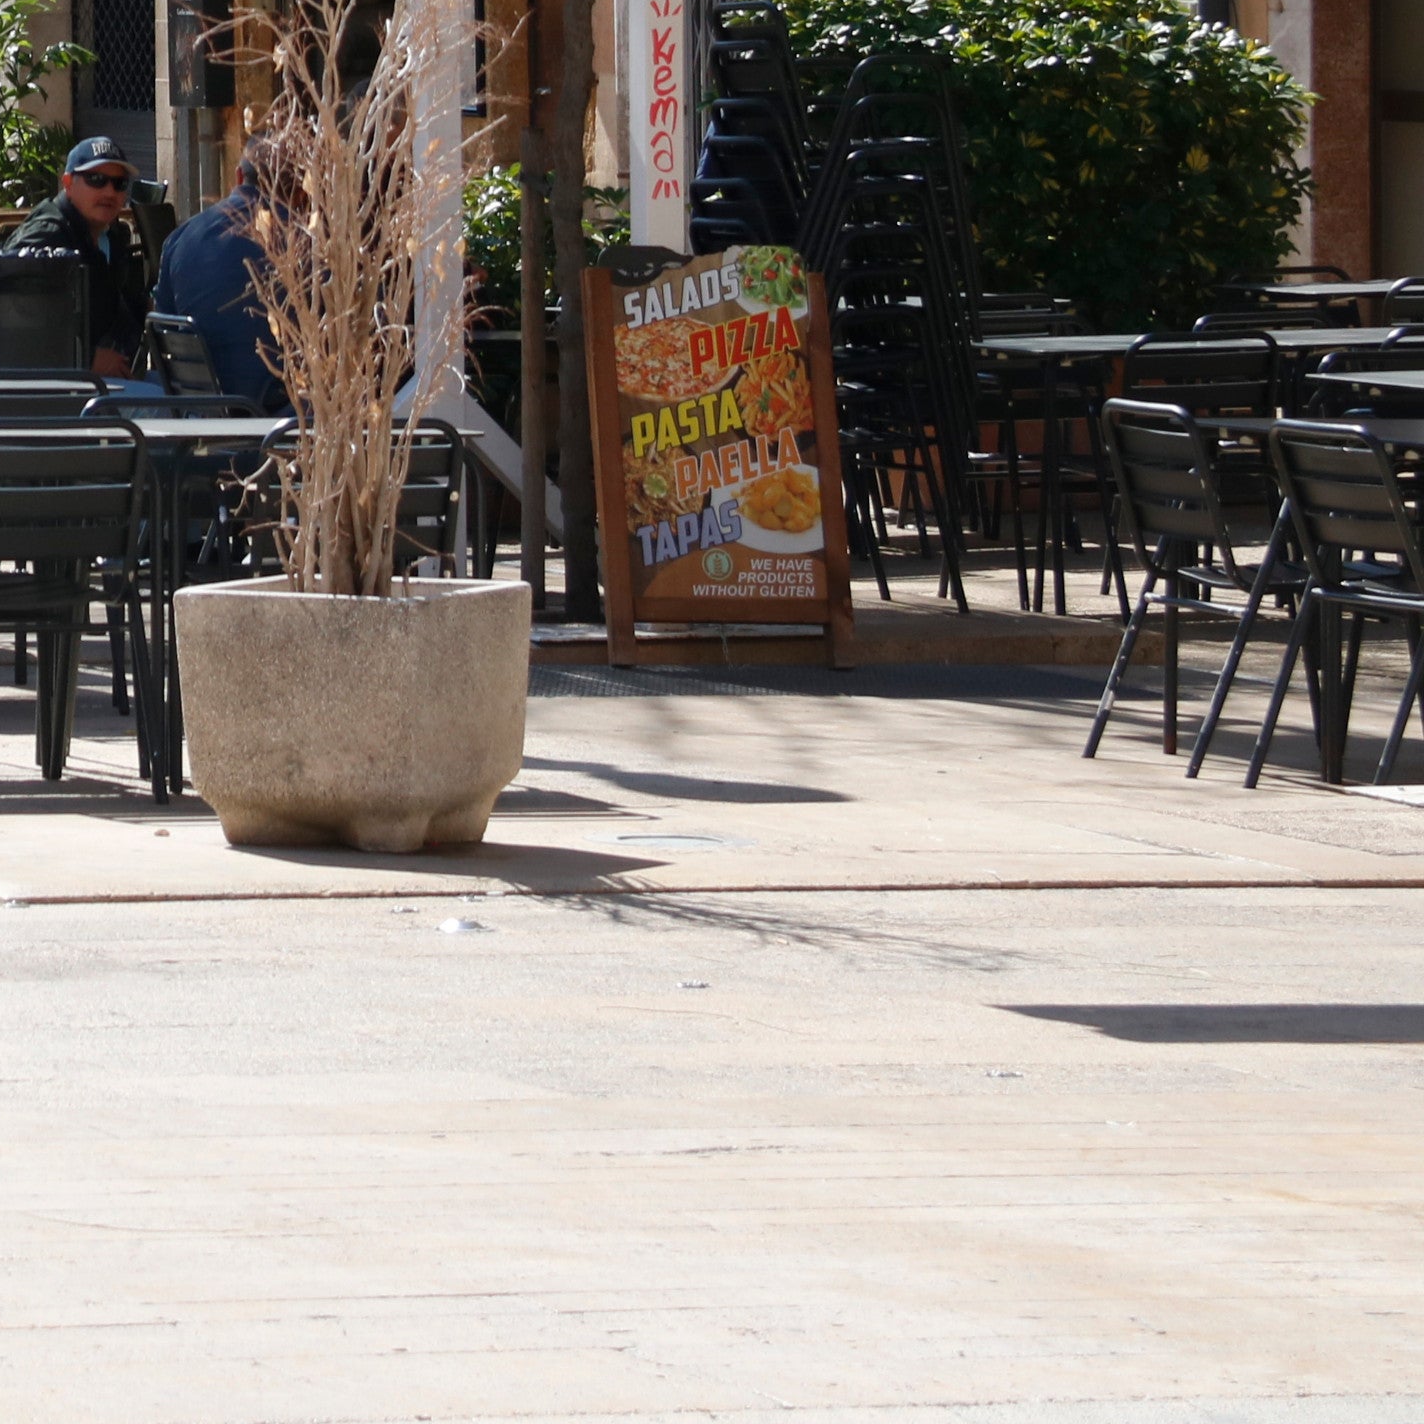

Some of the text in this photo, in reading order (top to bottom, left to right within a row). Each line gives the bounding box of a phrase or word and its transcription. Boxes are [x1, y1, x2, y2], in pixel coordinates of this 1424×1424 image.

[624, 263, 740, 329] SALADS
[688, 306, 801, 378] PIZZA
[631, 388, 743, 459] PASTA
[673, 426, 803, 501] PAELLA
[636, 499, 743, 567] TAPAS
[751, 559, 813, 571] WE HAVE
[692, 584, 816, 597] WITHOUT GLUTEN
[737, 572, 814, 584] PRODUCTS
